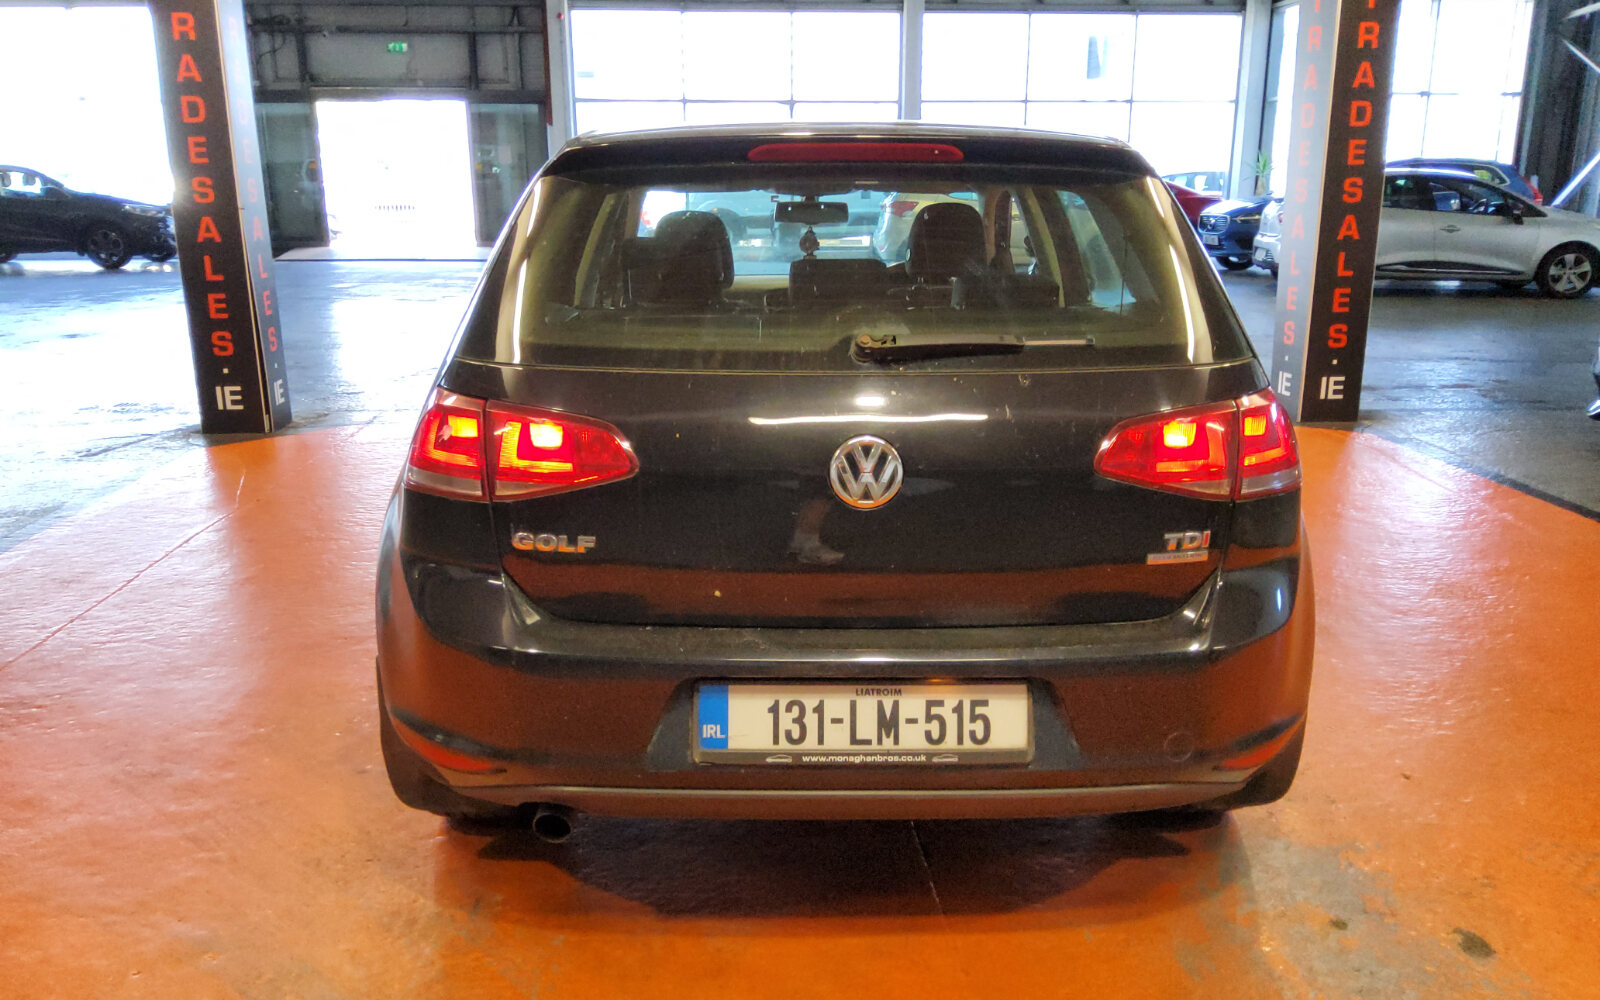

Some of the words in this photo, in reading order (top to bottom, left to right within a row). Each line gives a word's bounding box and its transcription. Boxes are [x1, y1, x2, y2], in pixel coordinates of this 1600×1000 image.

[832, 438, 901, 505] VW
[511, 532, 596, 553] GOLF
[1164, 530, 1211, 551] TDI
[855, 687, 902, 696] LIATROIM
[702, 724, 726, 738] IRL
[767, 699, 991, 746] 131-LM-515
[801, 753, 927, 764] www.monaghanbros.co.uk
